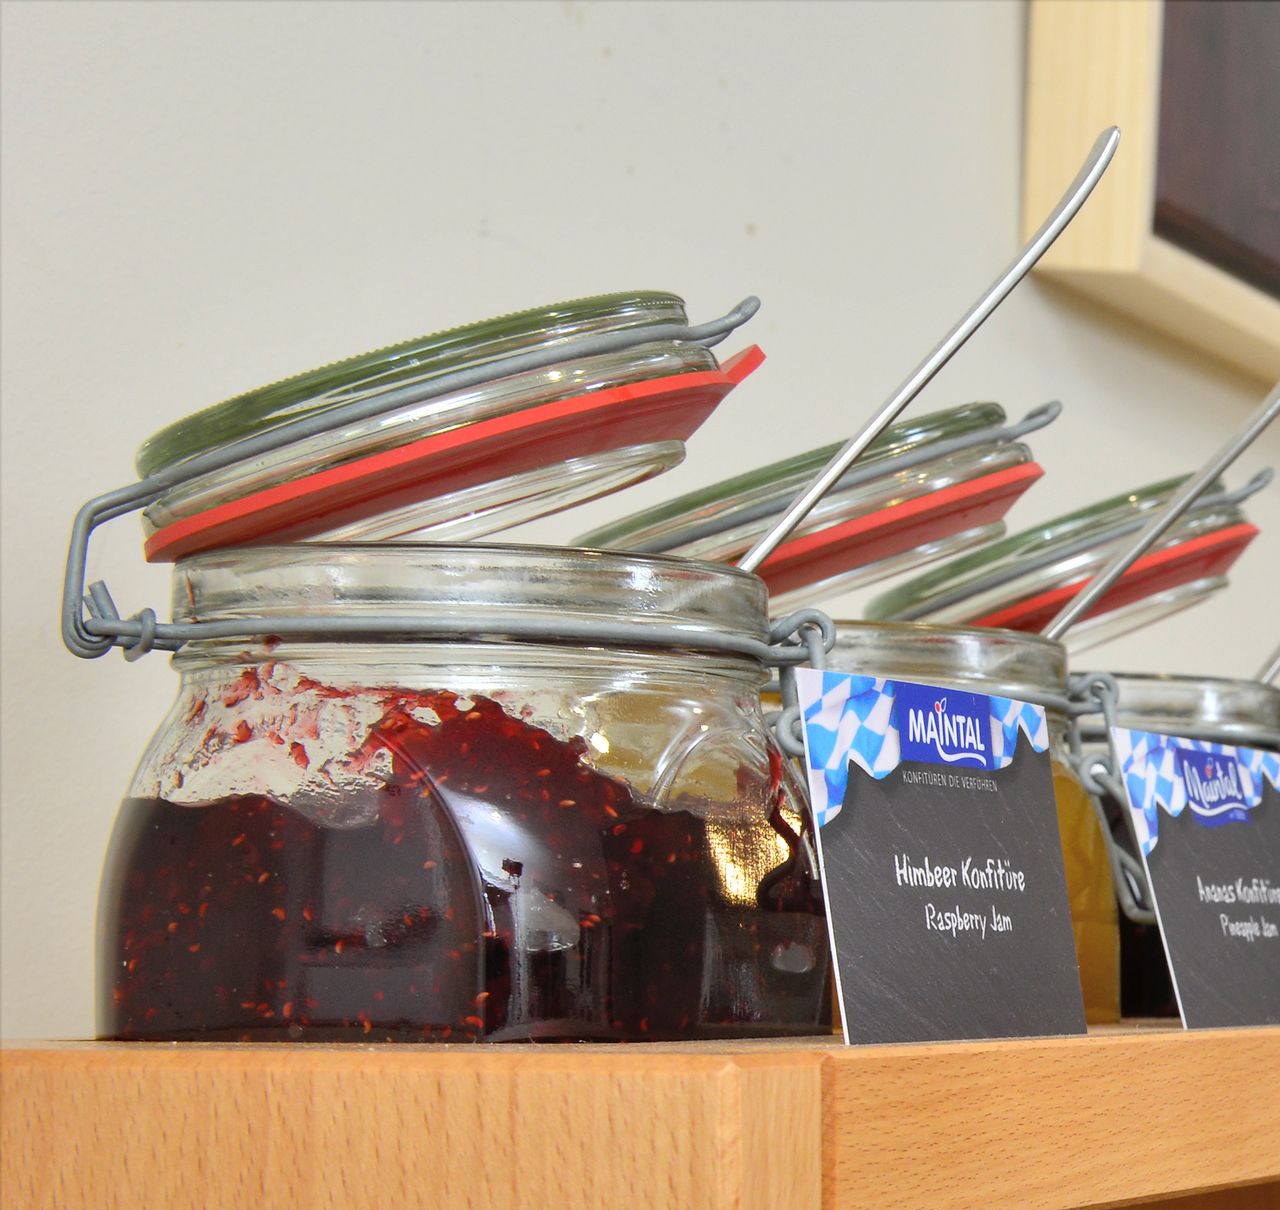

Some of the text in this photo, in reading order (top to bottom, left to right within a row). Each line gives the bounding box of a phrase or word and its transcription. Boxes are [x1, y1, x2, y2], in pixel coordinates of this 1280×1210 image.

[908, 702, 987, 756] MAINTAL
[902, 770, 998, 792] KONFITÜREN DIE VERFÜHREN
[894, 854, 1026, 892] Himbeer Konfitüre
[1196, 875, 1236, 905] Ananas
[924, 903, 1013, 939] Raspberry Jam
[1219, 914, 1260, 942] Pineapple
